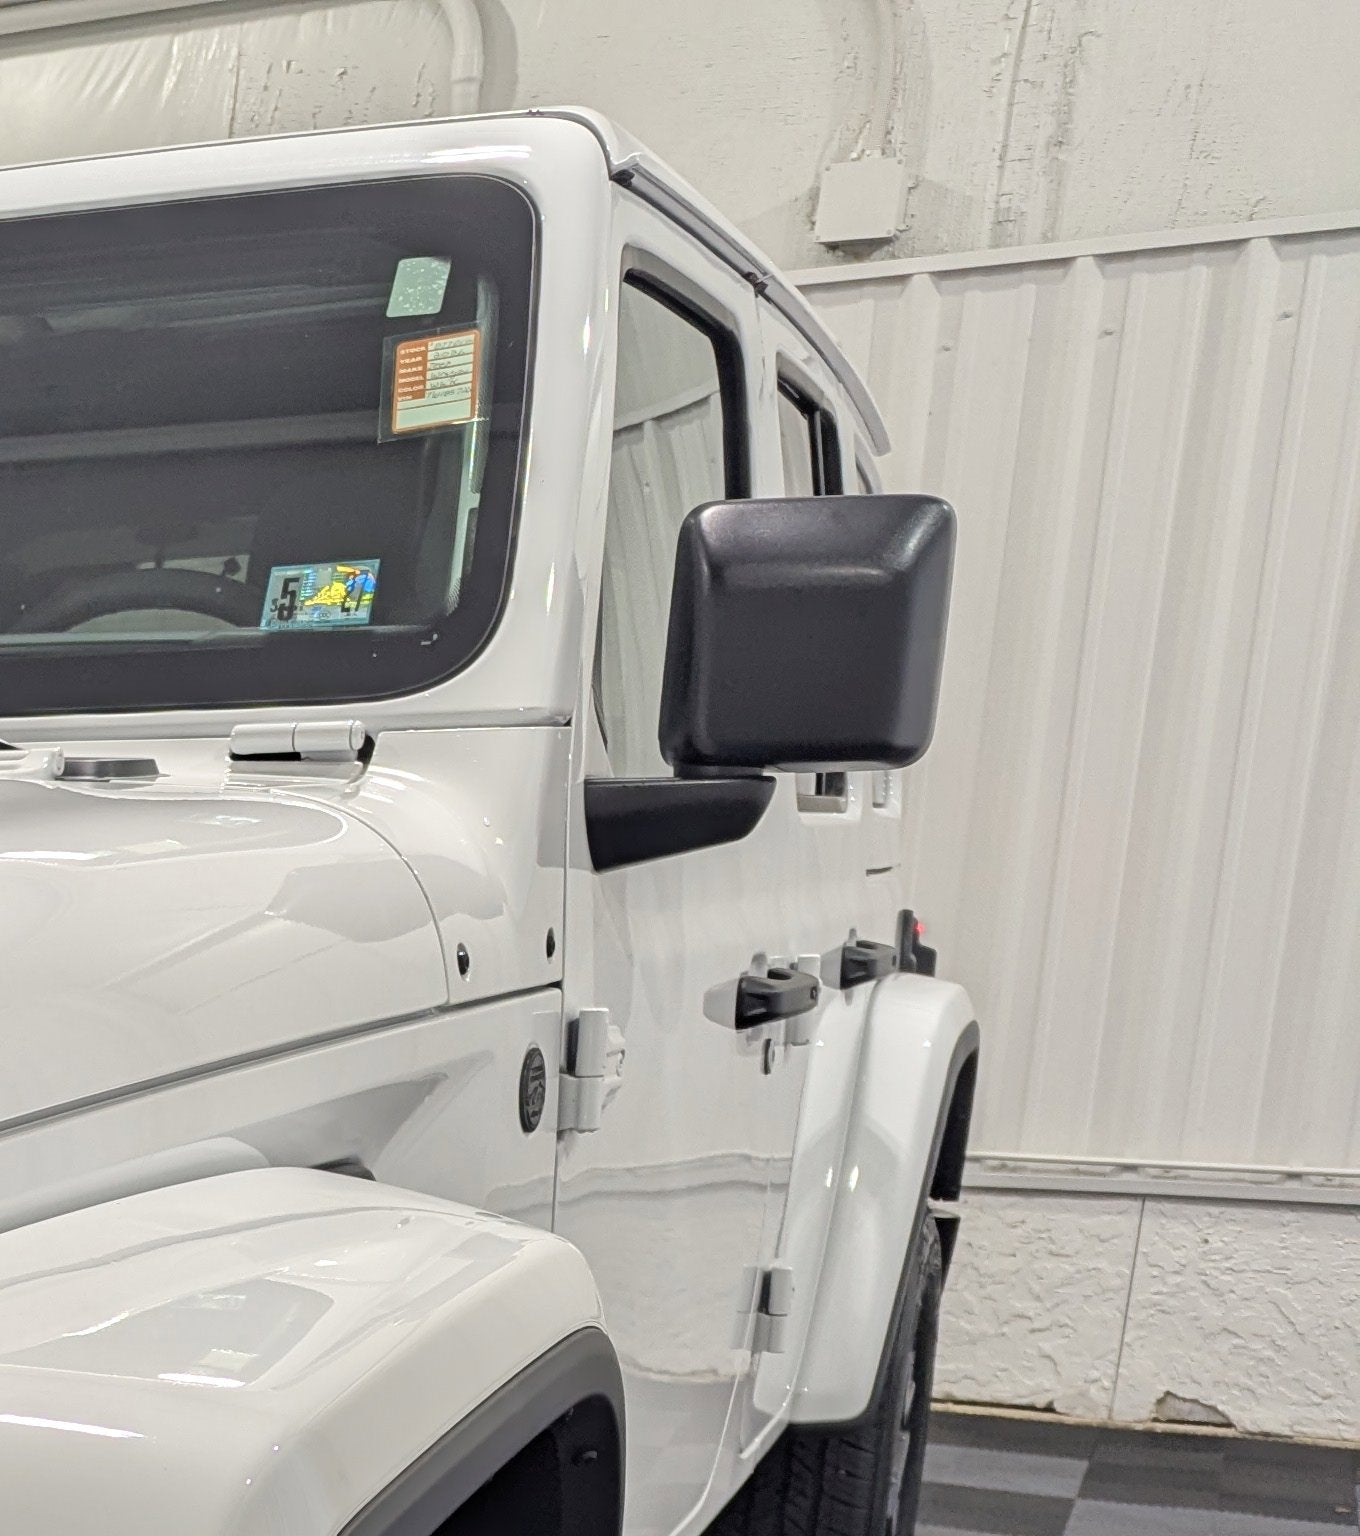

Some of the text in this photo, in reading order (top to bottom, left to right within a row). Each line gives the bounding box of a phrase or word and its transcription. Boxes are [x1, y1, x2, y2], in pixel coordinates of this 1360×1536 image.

[400, 356, 423, 365] YEAR
[399, 366, 423, 374] MAKE
[399, 375, 425, 384] MODEL
